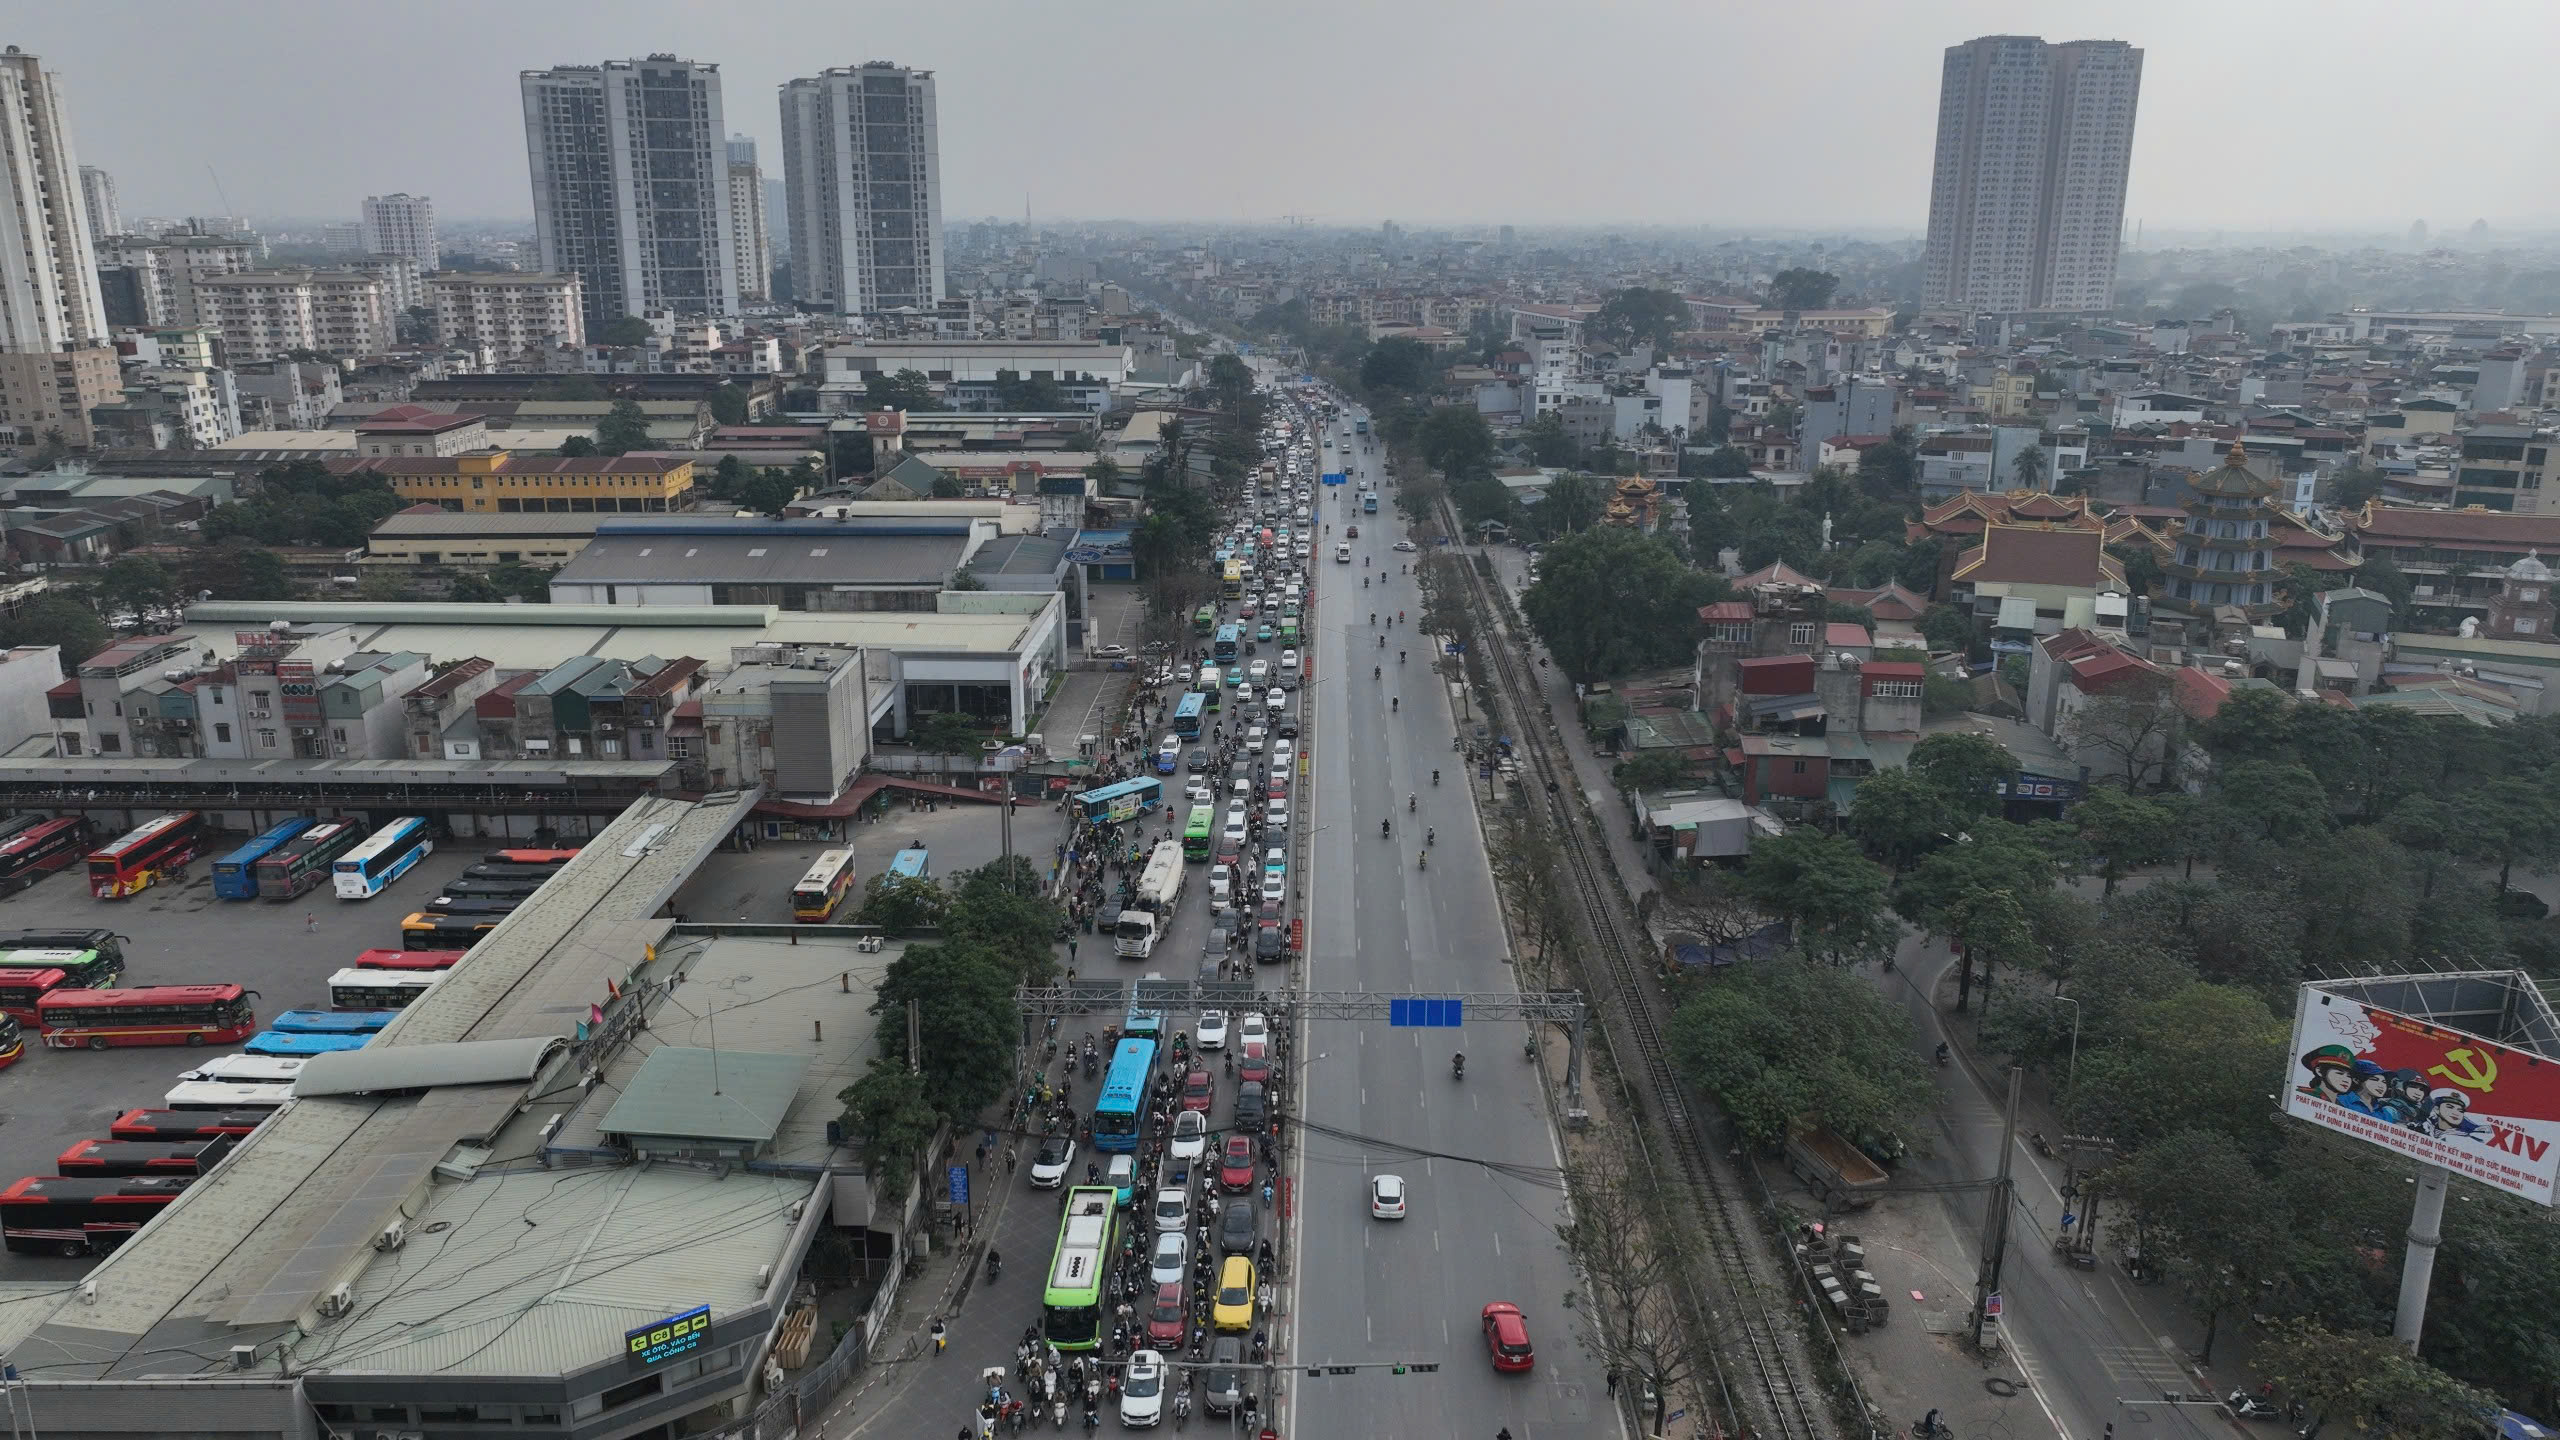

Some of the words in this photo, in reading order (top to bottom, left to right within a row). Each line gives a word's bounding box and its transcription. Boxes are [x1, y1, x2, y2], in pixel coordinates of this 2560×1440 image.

[1070, 551, 1095, 560] Ford
[2485, 1125, 2550, 1162] XIV
[2434, 1153, 2447, 1164] VIỆT
[2448, 1158, 2463, 1170] NAM
[653, 1330, 668, 1342] C8
[642, 1349, 651, 1357] XE
[670, 1337, 686, 1348] VÀO
[646, 1355, 662, 1364] QUA
